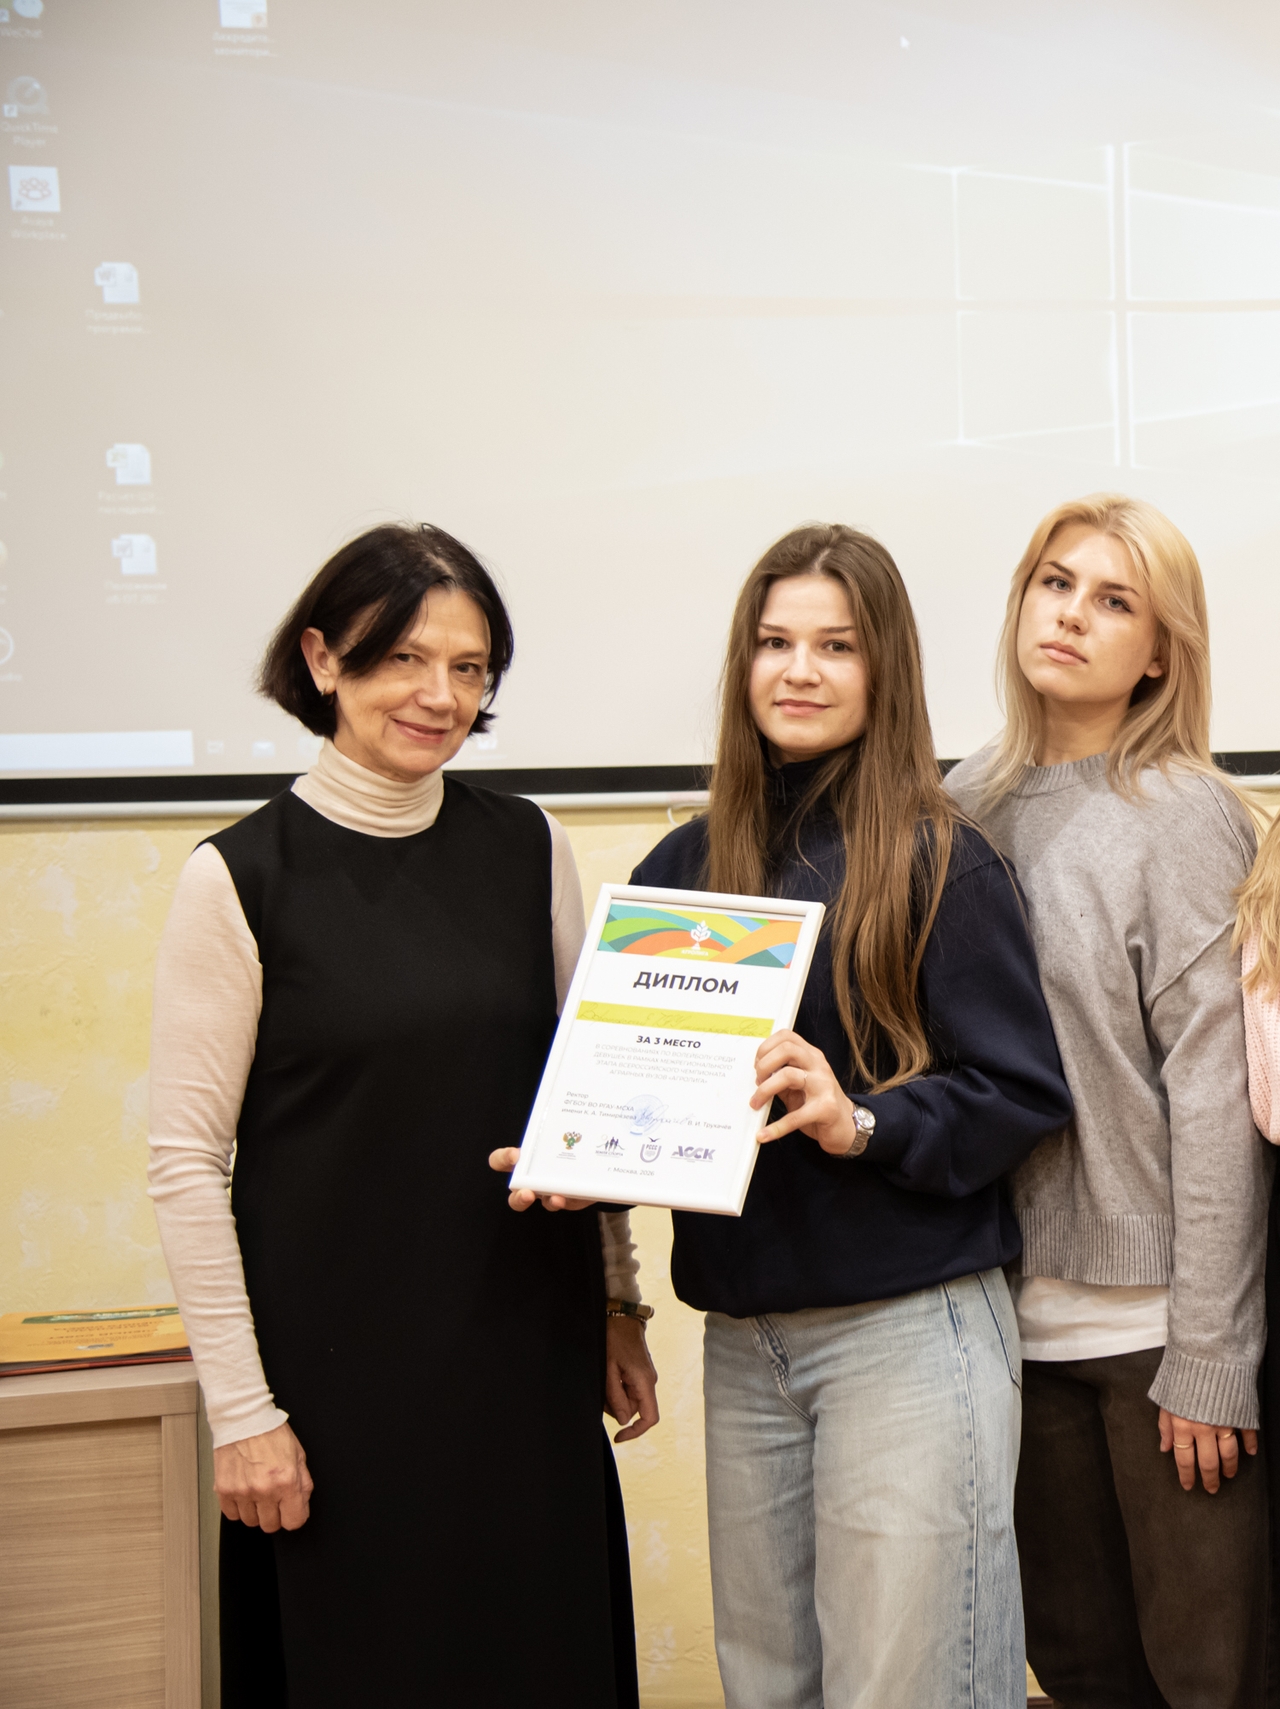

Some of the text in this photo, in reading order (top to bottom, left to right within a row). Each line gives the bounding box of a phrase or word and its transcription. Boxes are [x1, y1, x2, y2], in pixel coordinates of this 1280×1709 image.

[633, 971, 739, 995] ДИПЛОМ
[636, 1035, 702, 1049] ЗА 3 МЕСТО
[593, 1051, 626, 1060] ДЕВУШЕК
[633, 1055, 659, 1063] РАМКАХ
[596, 1059, 618, 1067] ЭТАПА
[713, 1055, 736, 1063] СРЕДИ
[566, 1091, 589, 1099] Ректор
[672, 1145, 716, 1160] АССК
